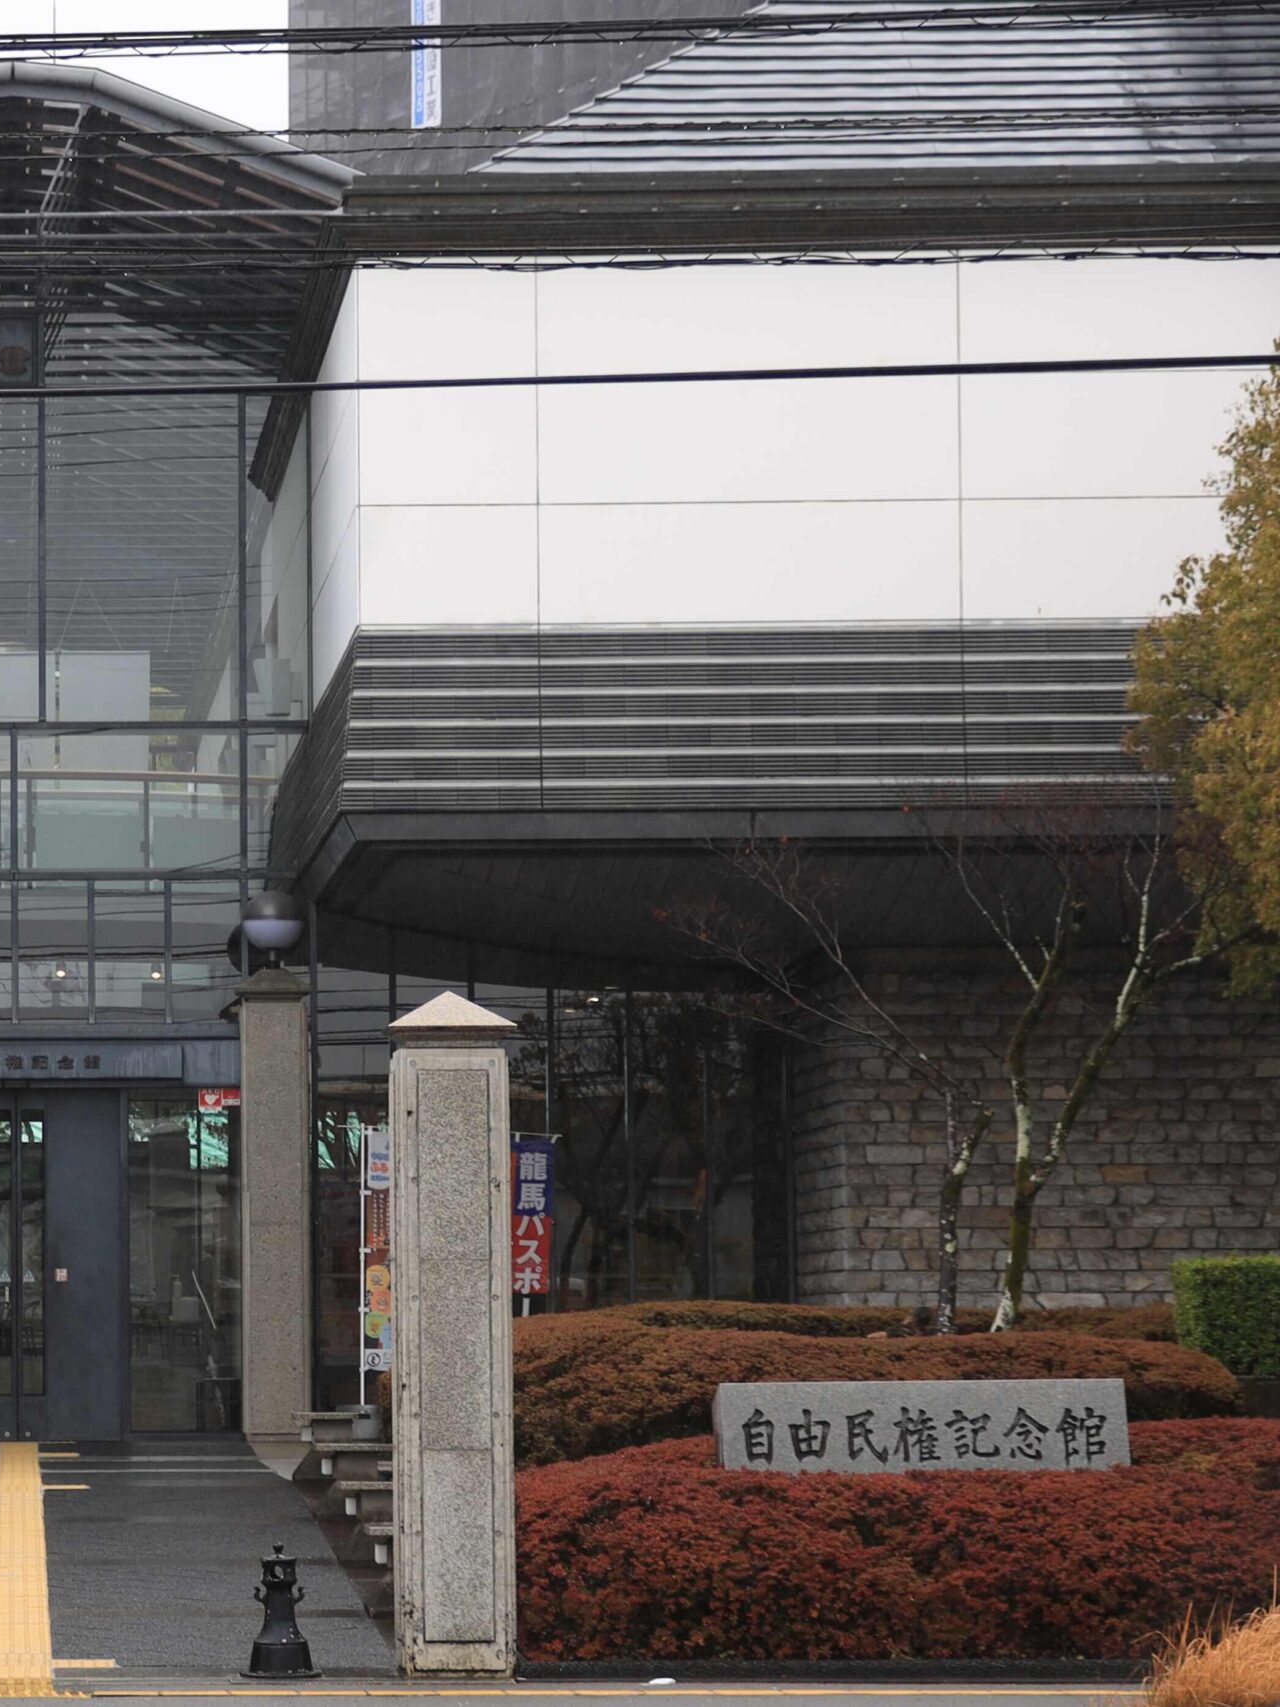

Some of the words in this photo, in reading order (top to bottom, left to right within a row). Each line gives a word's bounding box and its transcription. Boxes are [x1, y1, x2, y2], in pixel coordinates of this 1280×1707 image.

[740, 1406, 1108, 1466] 自由民権記念館
